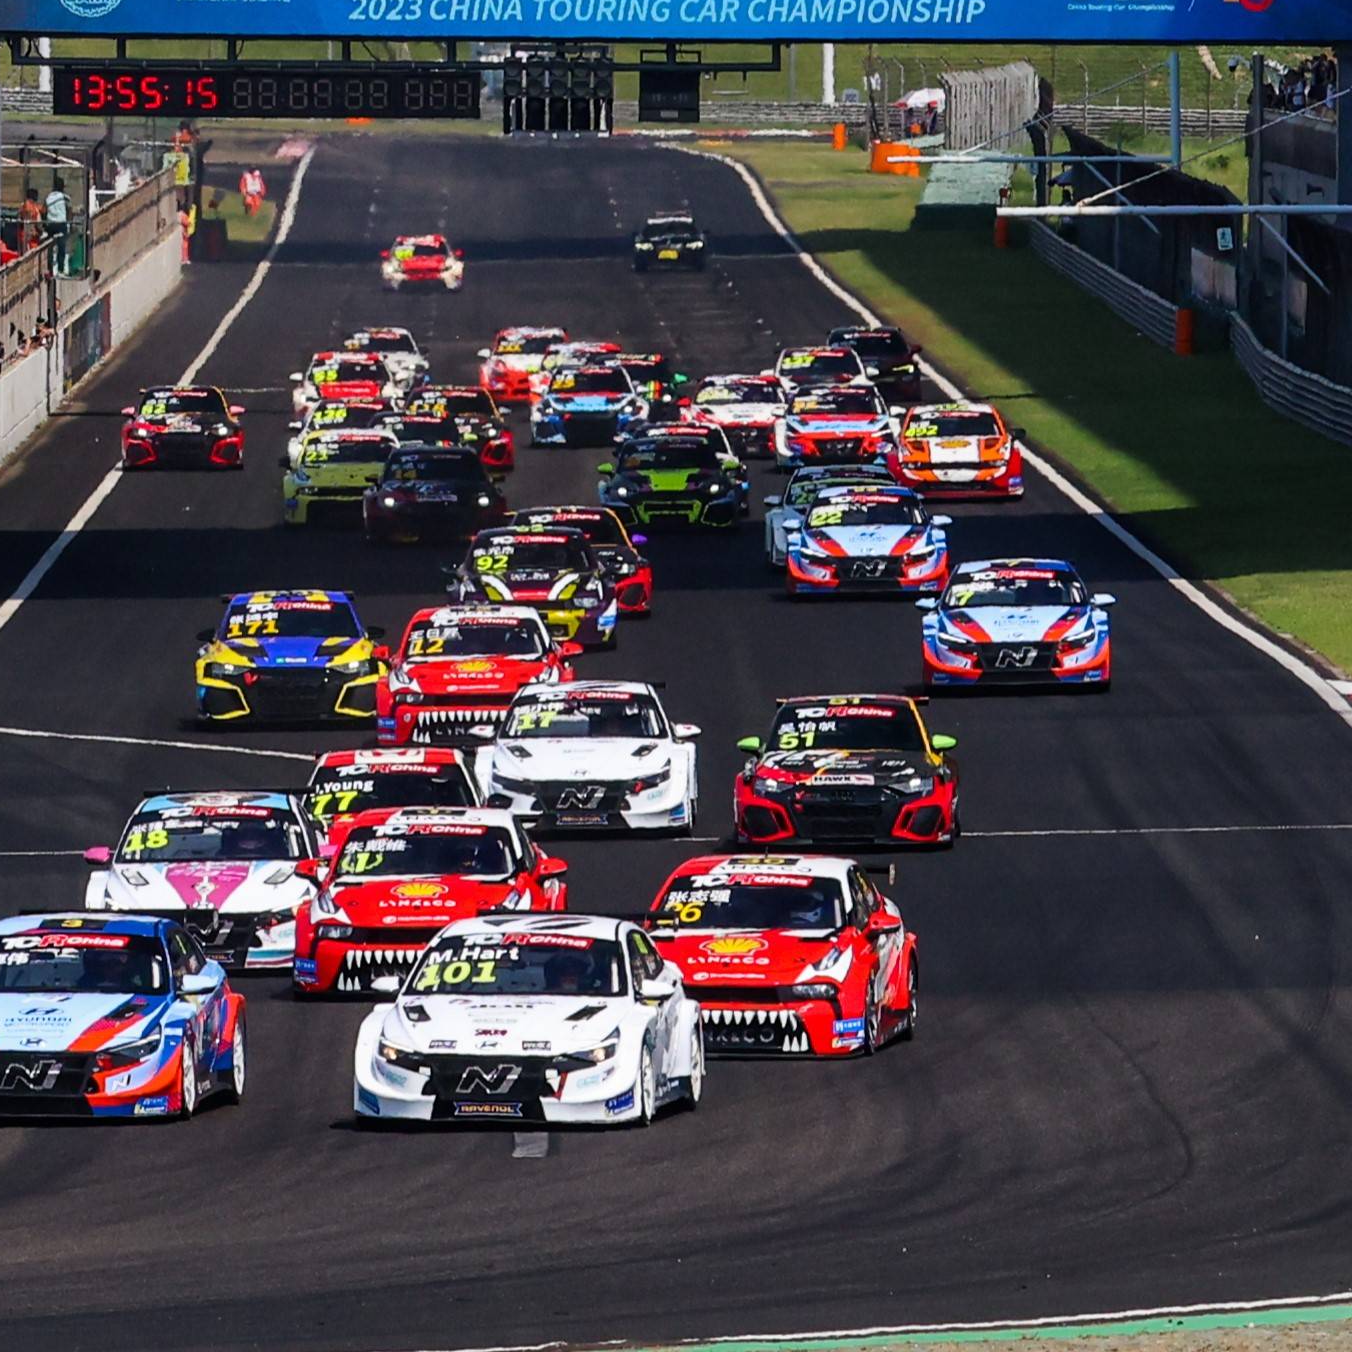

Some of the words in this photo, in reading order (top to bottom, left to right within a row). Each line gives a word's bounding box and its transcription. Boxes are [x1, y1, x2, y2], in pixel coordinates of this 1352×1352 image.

[73, 76, 218, 110] 13:55:15
[477, 555, 508, 570] 92
[227, 620, 279, 639] 171
[412, 638, 444, 655] 12
[779, 732, 816, 749] 51
[814, 776, 852, 784] HAWK
[123, 830, 168, 853] 18
[67, 936, 125, 947] China
[462, 933, 528, 948] TCR
[529, 935, 589, 949] China
[428, 946, 520, 965] M.Hart
[416, 961, 497, 991] 101
[459, 1104, 515, 1115] RAVENOL
